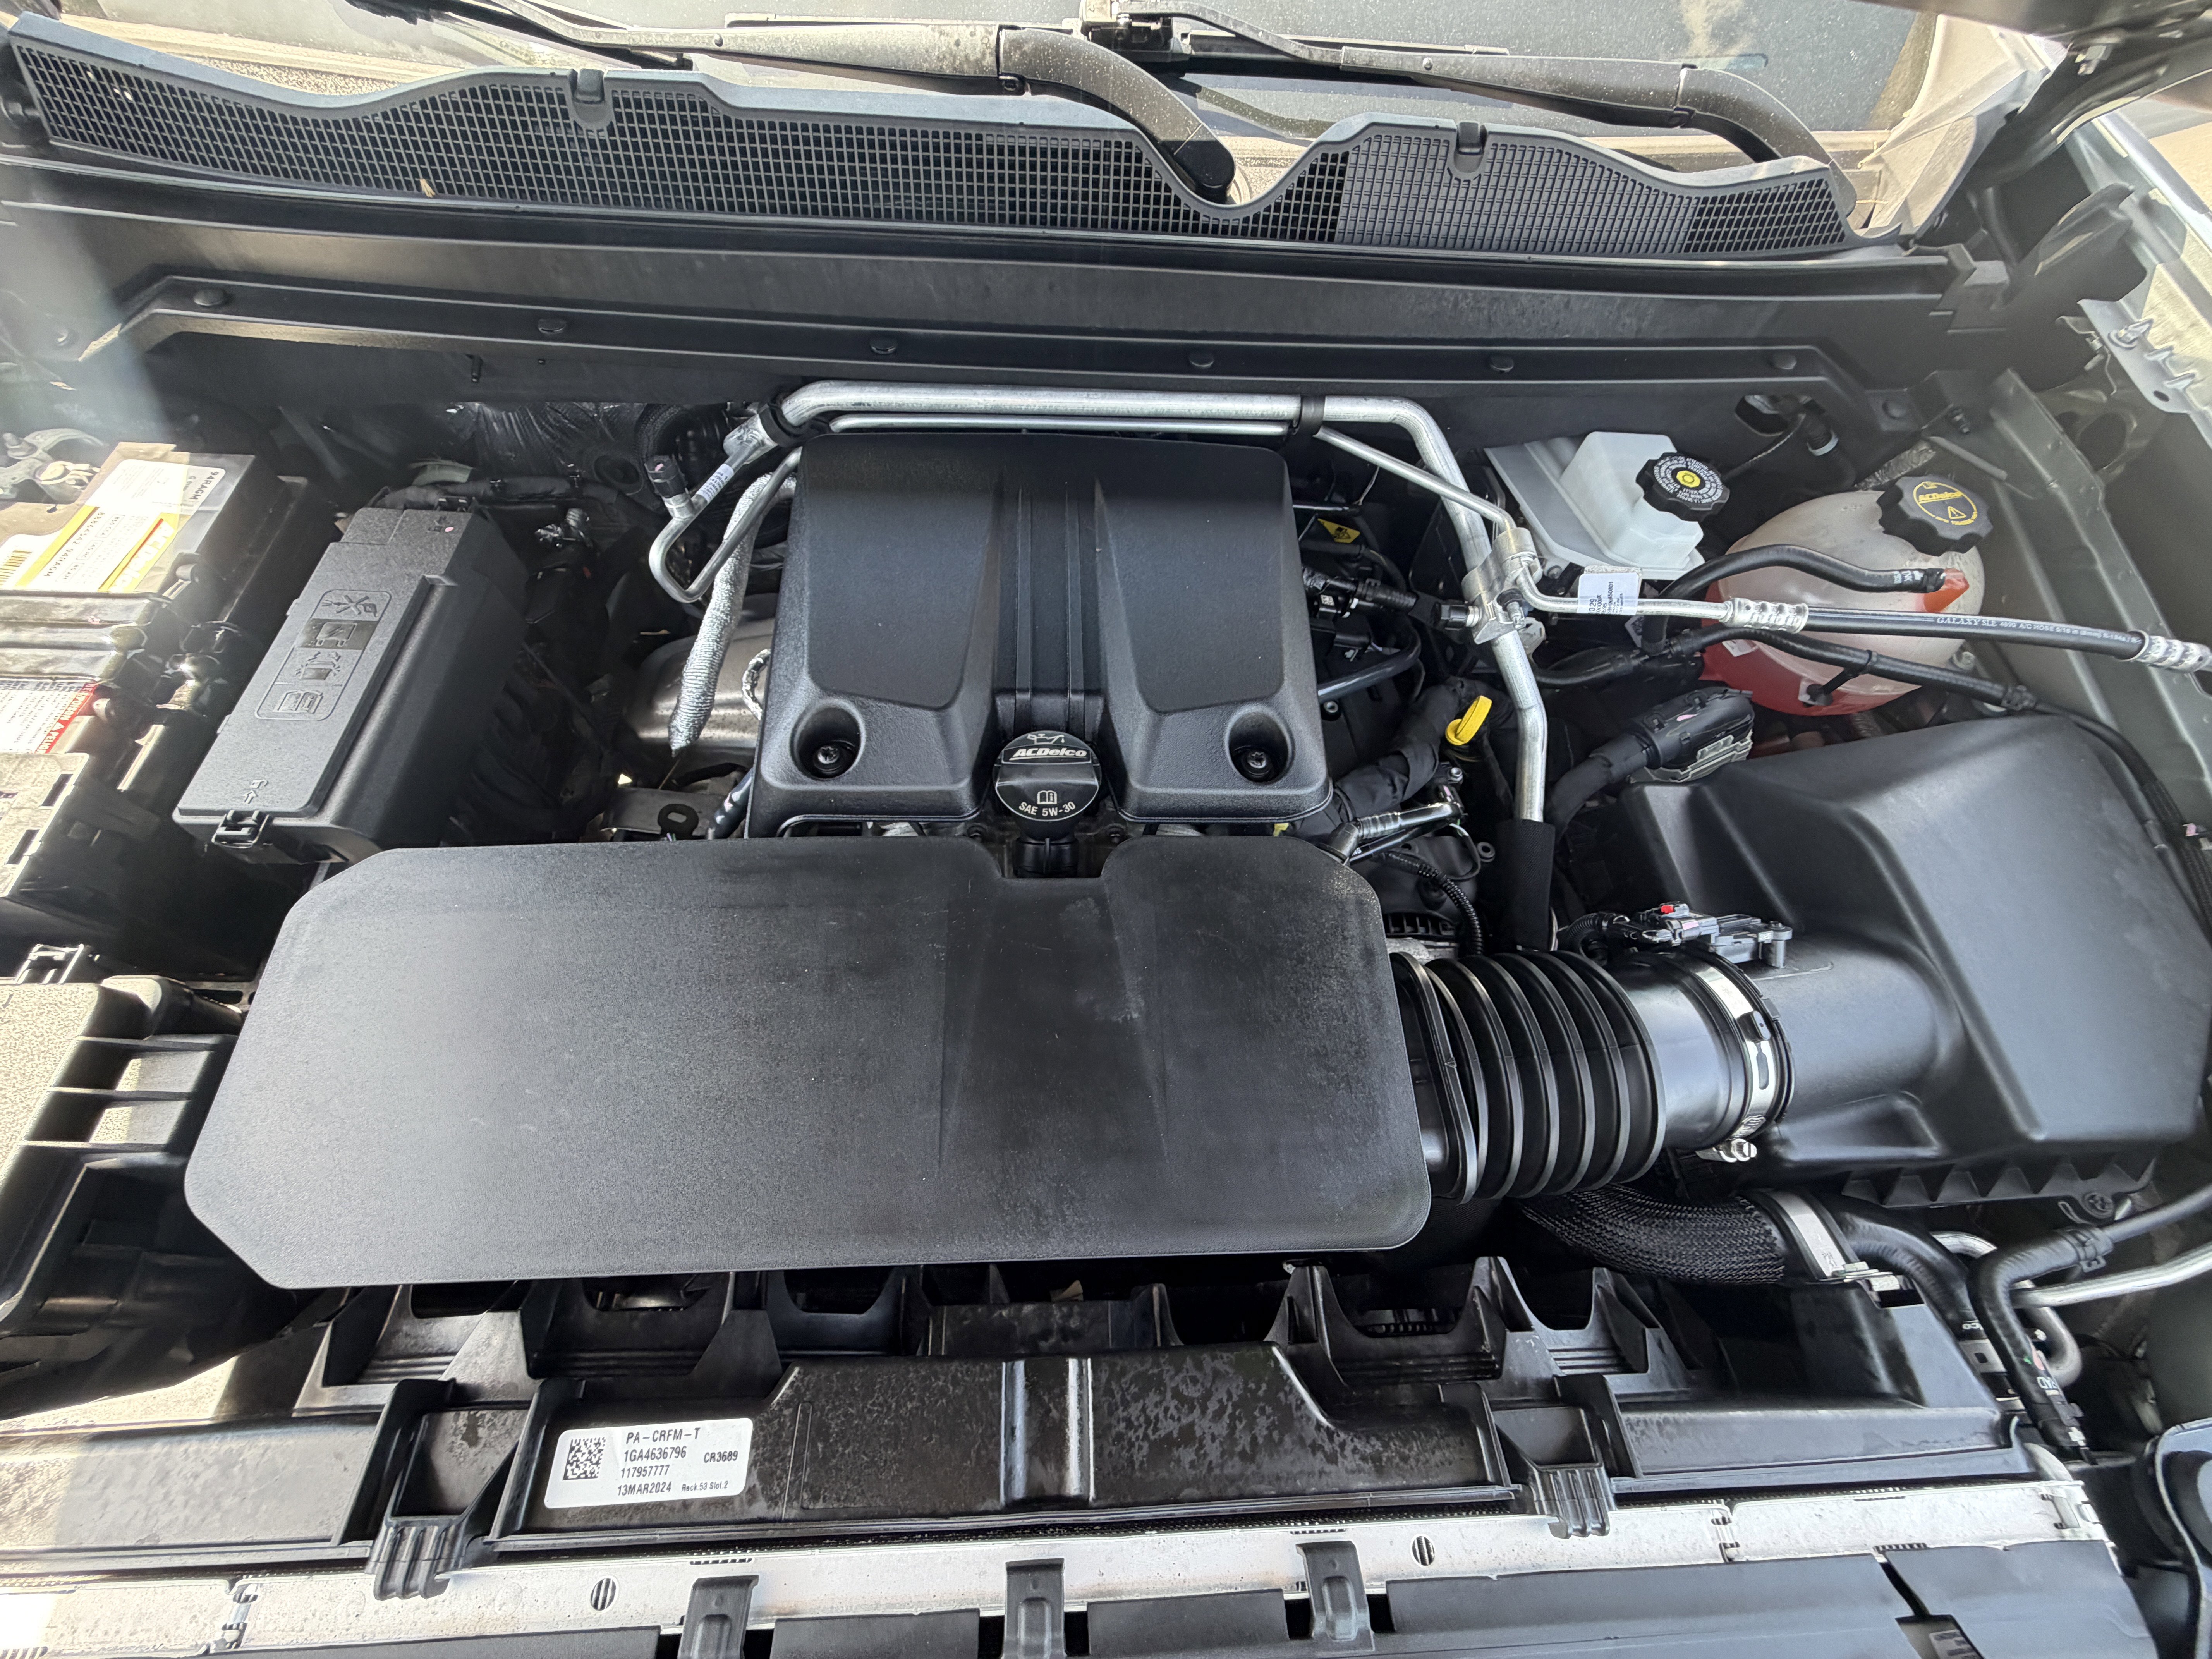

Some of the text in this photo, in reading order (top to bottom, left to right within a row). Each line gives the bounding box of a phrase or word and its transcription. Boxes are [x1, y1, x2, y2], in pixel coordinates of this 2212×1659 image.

[189, 471, 219, 500] 94RAGM
[1937, 617, 1980, 625] GALAXY
[1012, 748, 1087, 757] ACDelco
[1018, 801, 1076, 817] SAE 5W-30
[624, 1446, 687, 1462] 1GA4636796
[704, 1450, 738, 1463] CR3689
[621, 1465, 670, 1479] 117957777
[618, 1481, 672, 1496] 13MAR2024
